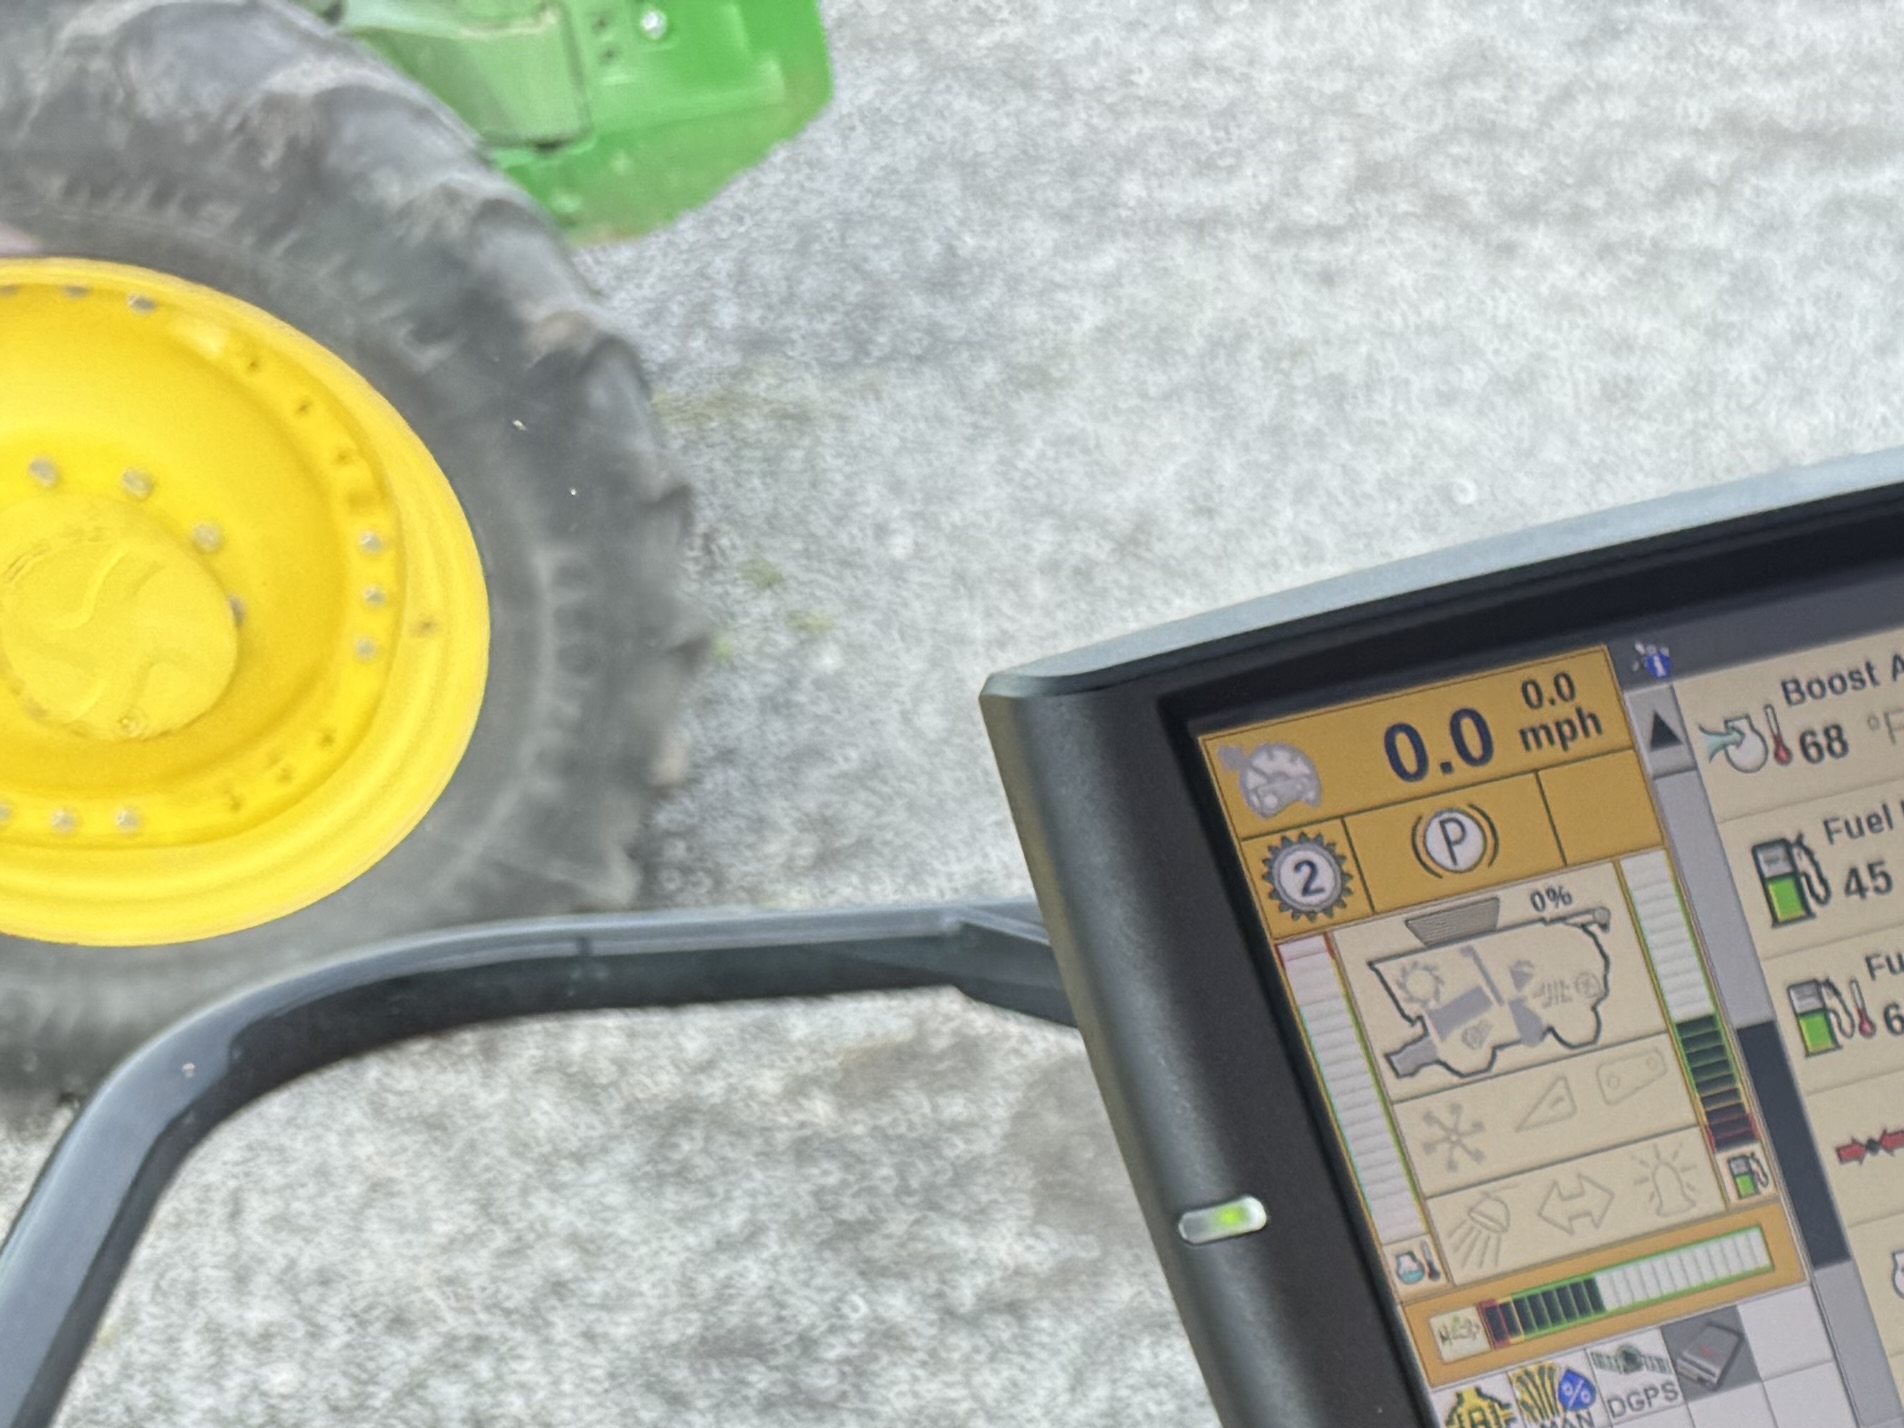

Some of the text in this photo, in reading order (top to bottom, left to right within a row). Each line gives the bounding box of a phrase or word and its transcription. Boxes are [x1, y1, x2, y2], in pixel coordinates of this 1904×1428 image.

[1520, 672, 1576, 711] 0.0
[1781, 661, 1881, 707] Boost
[1384, 705, 1604, 782] 0.0 mph
[1799, 722, 1850, 766] 68
[1822, 802, 1896, 846] Fuel
[1843, 859, 1895, 901] 45
[1607, 1381, 1681, 1420] DGPS
